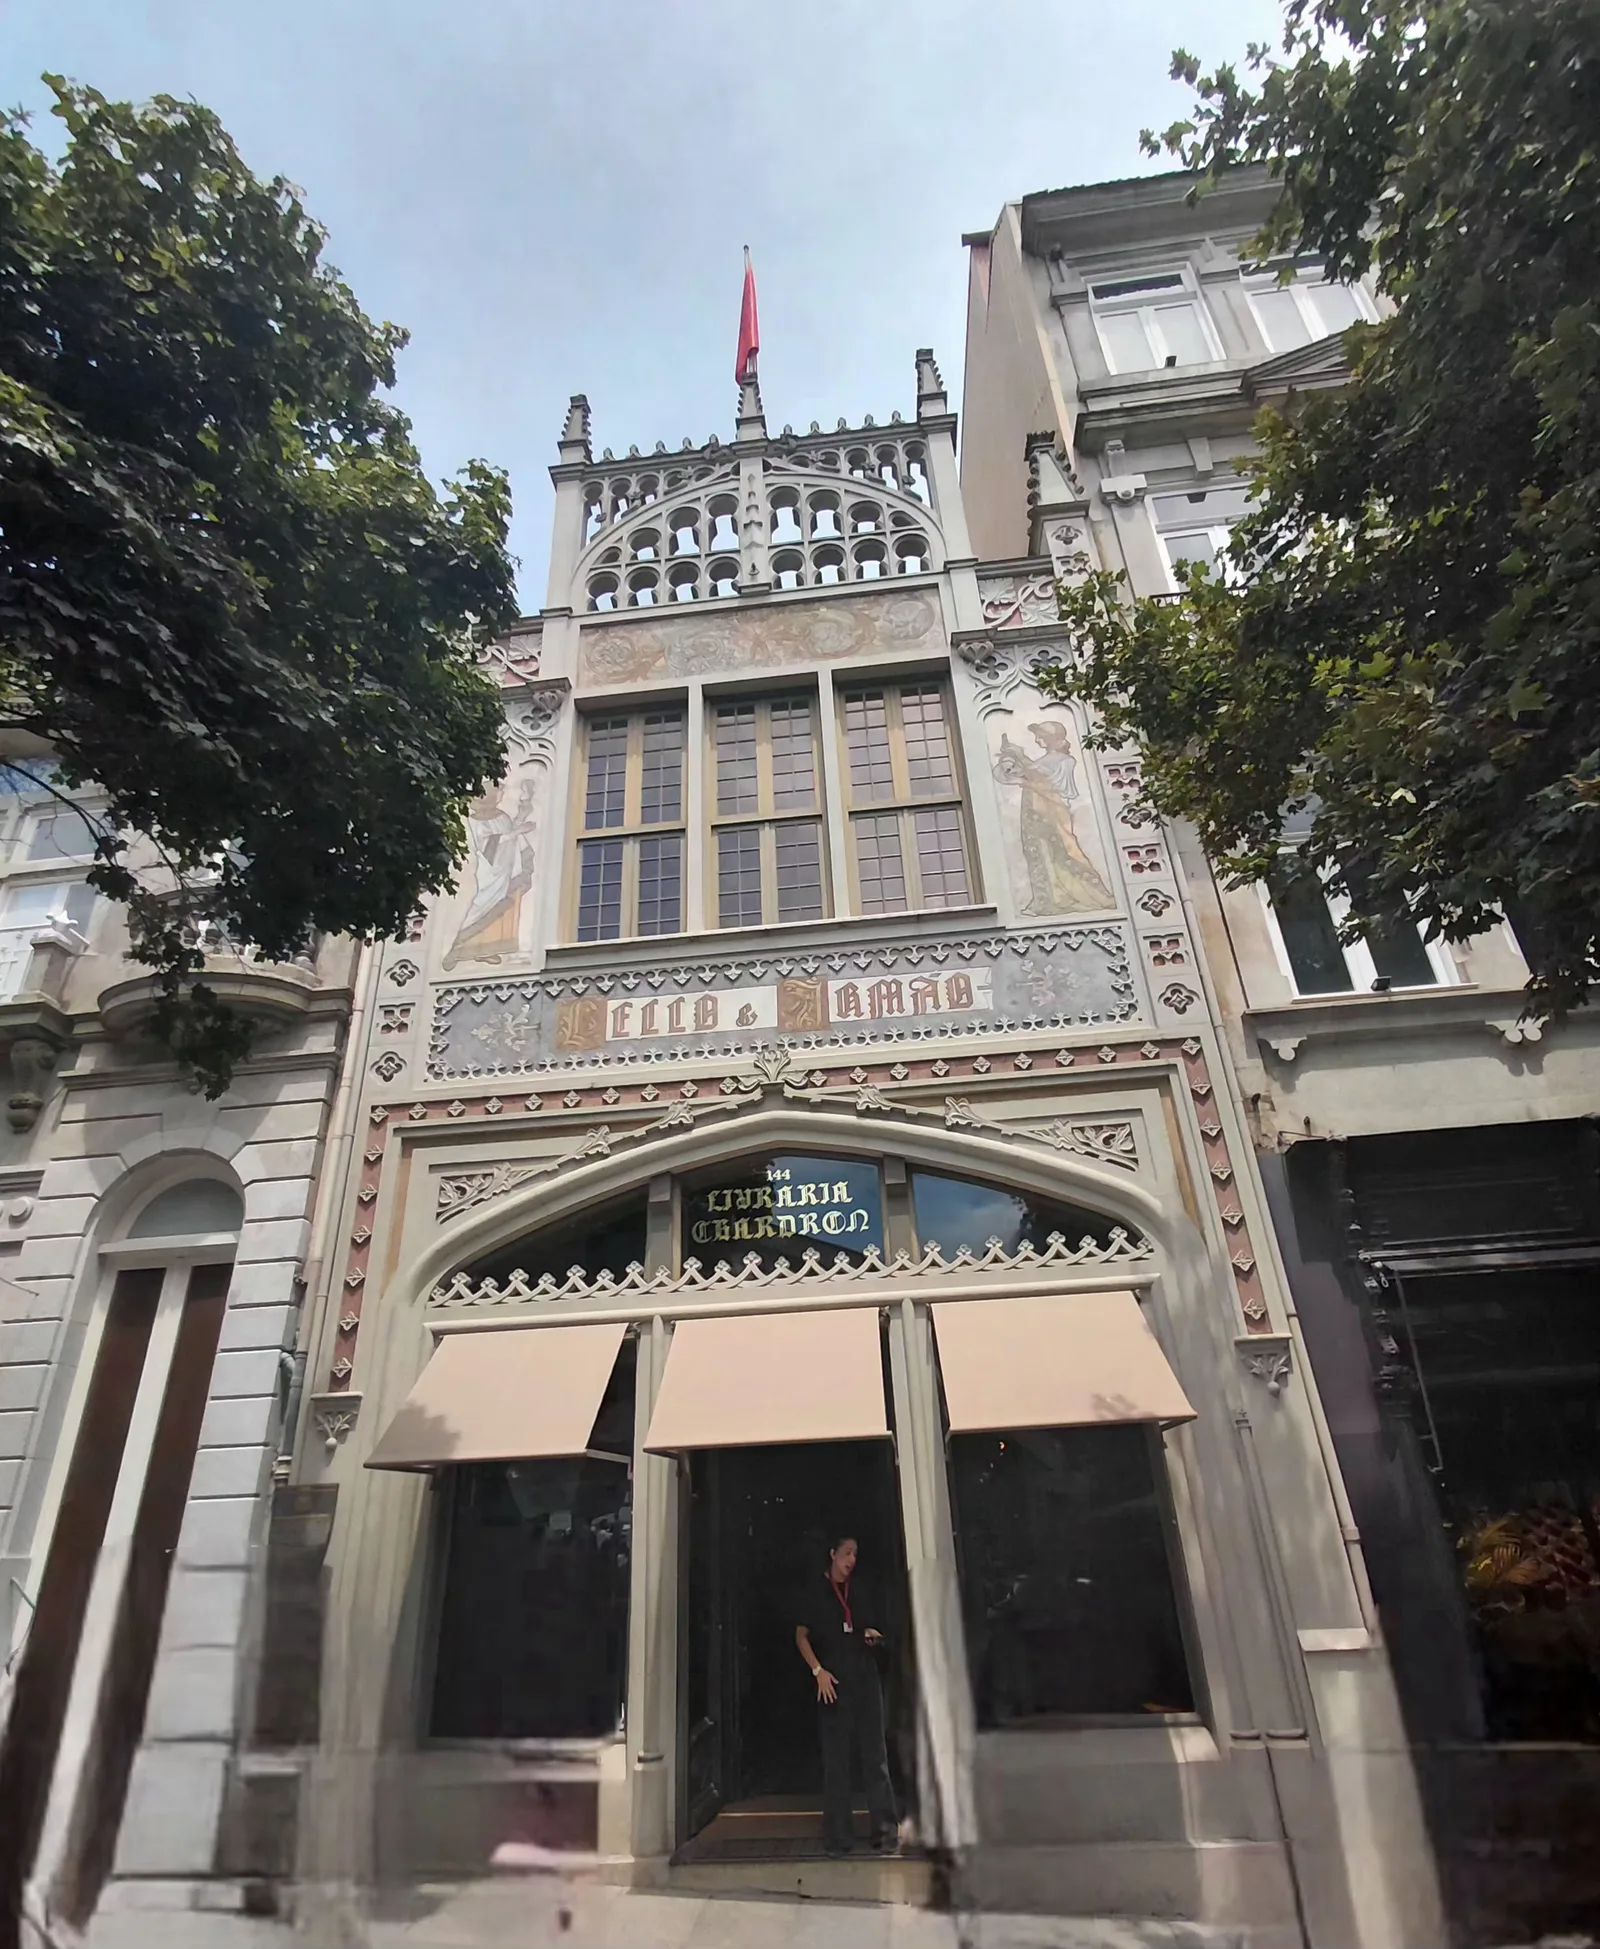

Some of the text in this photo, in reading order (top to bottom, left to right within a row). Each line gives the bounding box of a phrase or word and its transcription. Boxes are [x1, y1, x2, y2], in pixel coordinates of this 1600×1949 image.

[557, 971, 974, 1047] LELLO & IRMÃO
[766, 1168, 791, 1182] 144
[707, 1180, 853, 1213] LIVRARIA
[691, 1208, 870, 1244] CHARDRON
